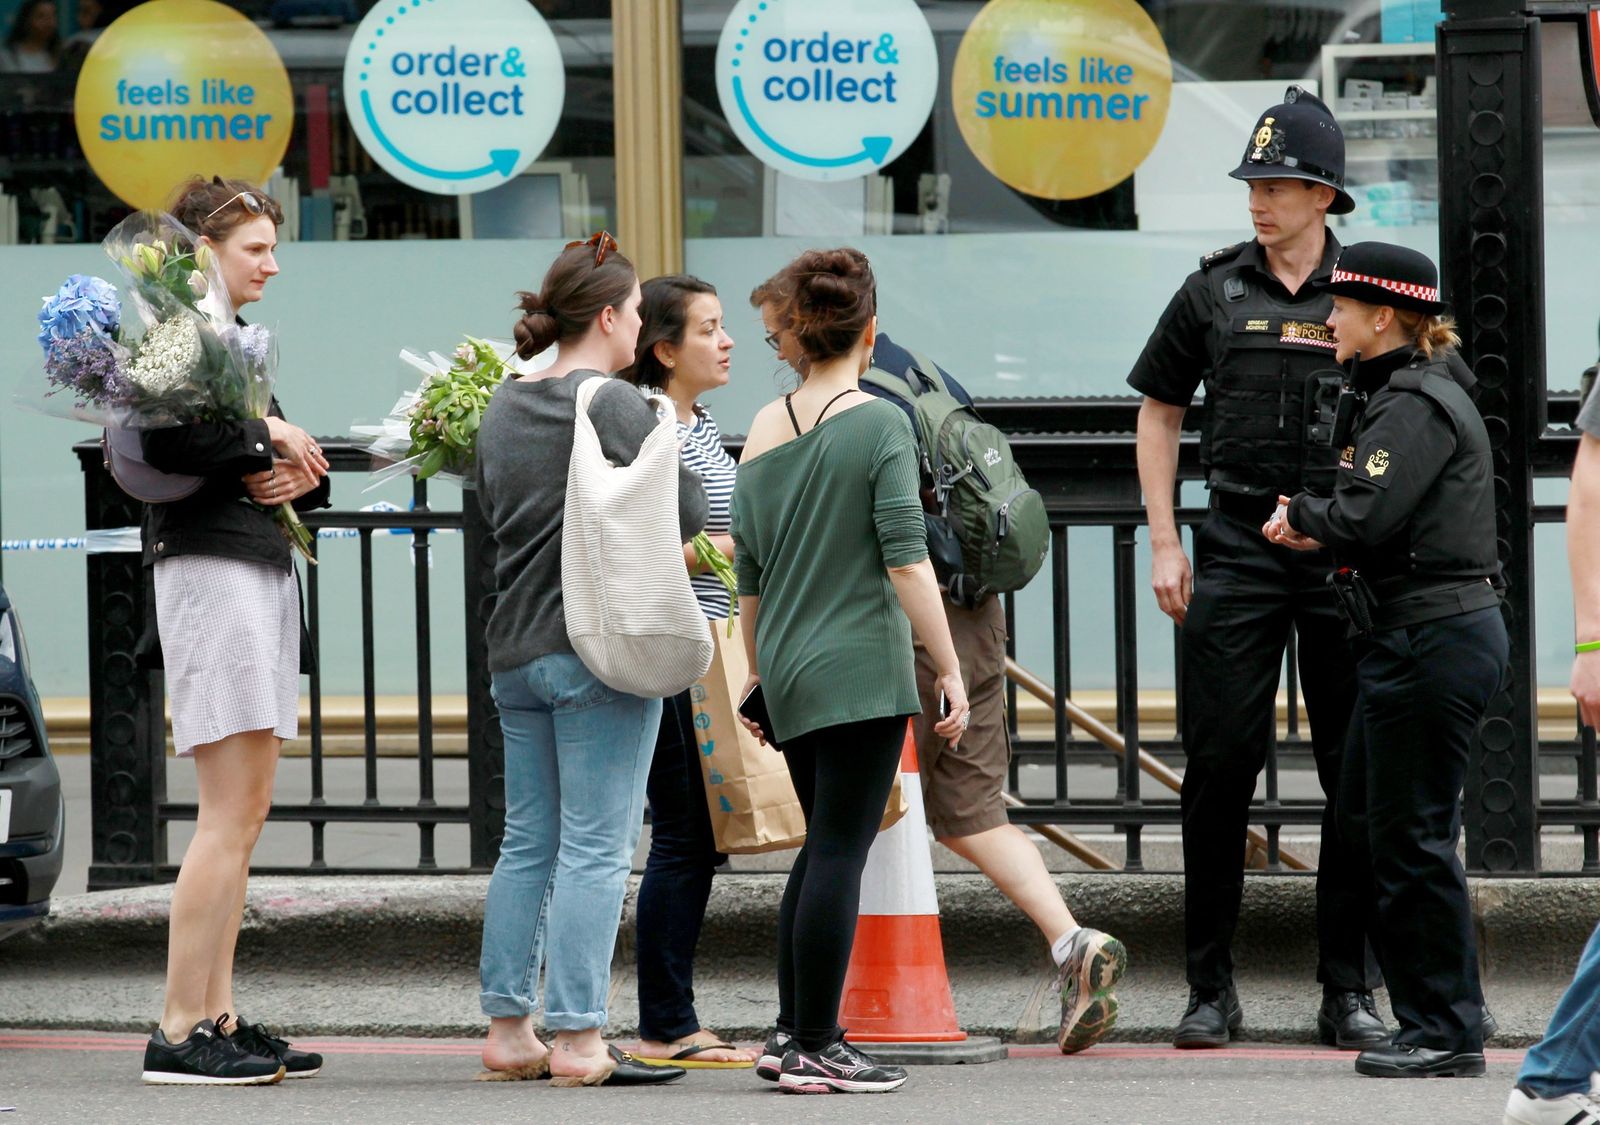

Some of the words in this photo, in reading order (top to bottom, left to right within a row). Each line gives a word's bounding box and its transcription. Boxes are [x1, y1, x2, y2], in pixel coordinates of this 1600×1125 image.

[391, 46, 527, 78] order&
[763, 32, 899, 64] order&
[994, 55, 1068, 83] feels
[1080, 56, 1133, 85] like
[117, 79, 190, 105] feels
[202, 79, 255, 105] like
[391, 82, 525, 115] collect
[762, 69, 897, 102] collect
[975, 91, 1149, 120] summer
[99, 113, 273, 141] summer
[1369, 454, 1390, 468] 0340
[1376, 449, 1389, 458] CP
